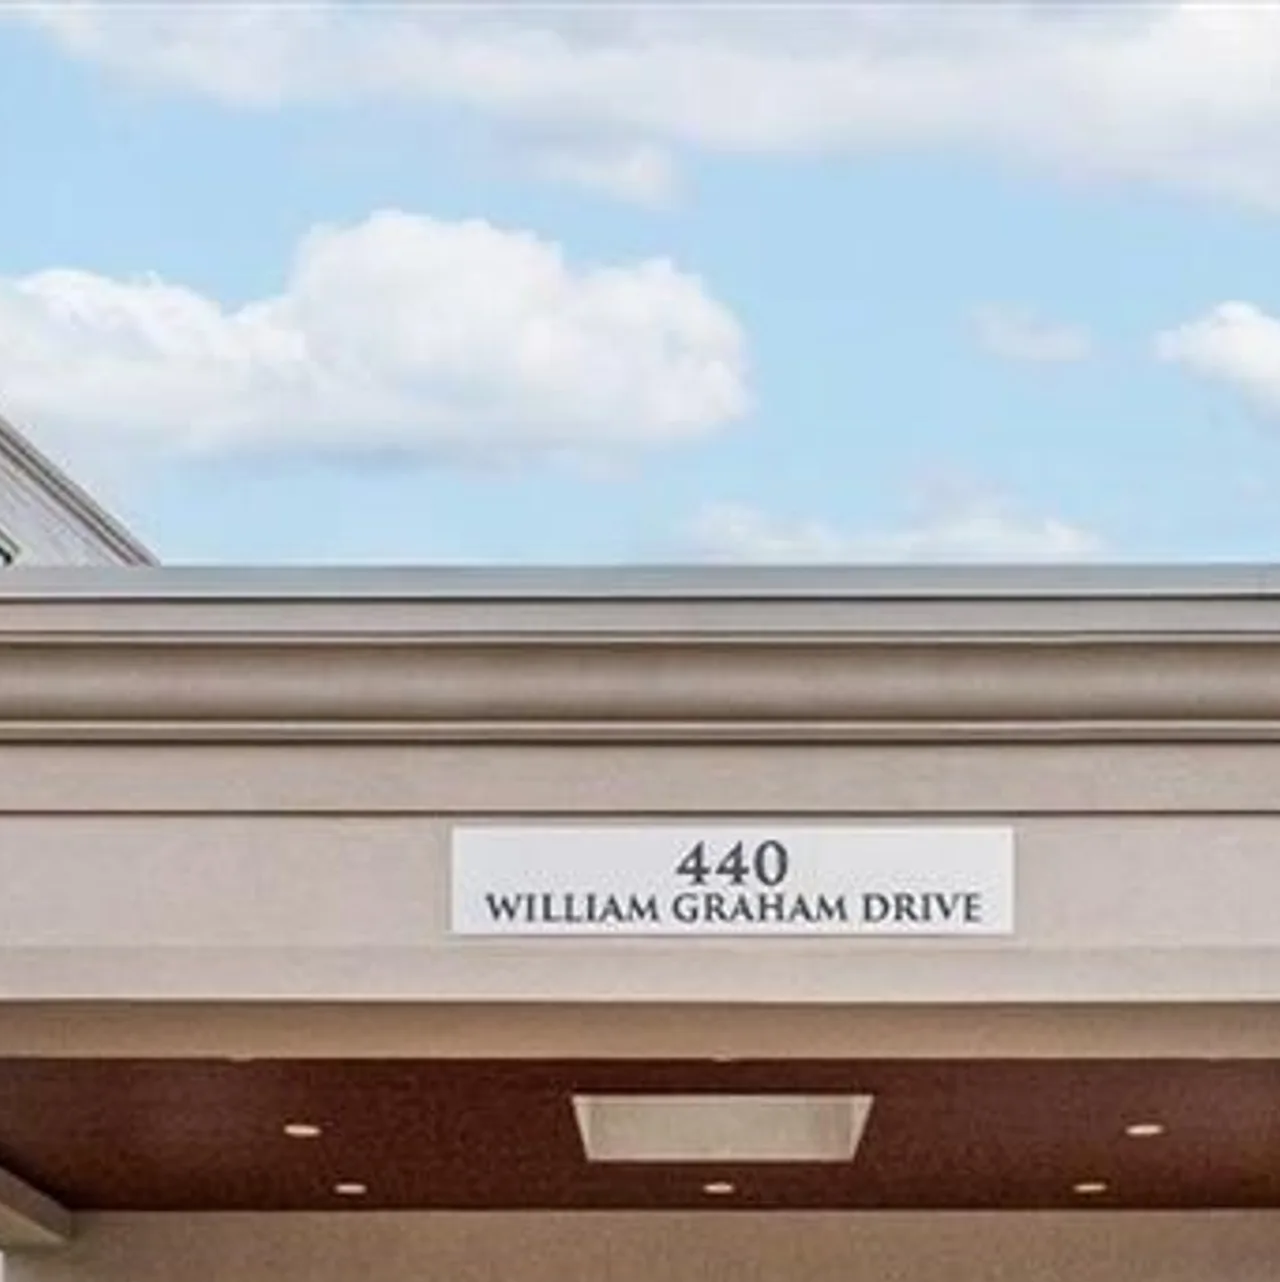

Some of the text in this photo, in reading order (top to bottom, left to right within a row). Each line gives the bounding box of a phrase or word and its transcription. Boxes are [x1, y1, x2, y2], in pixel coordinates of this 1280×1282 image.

[676, 839, 789, 887] 440
[486, 893, 982, 923] WILLIAM GRAHAM DRIVE
